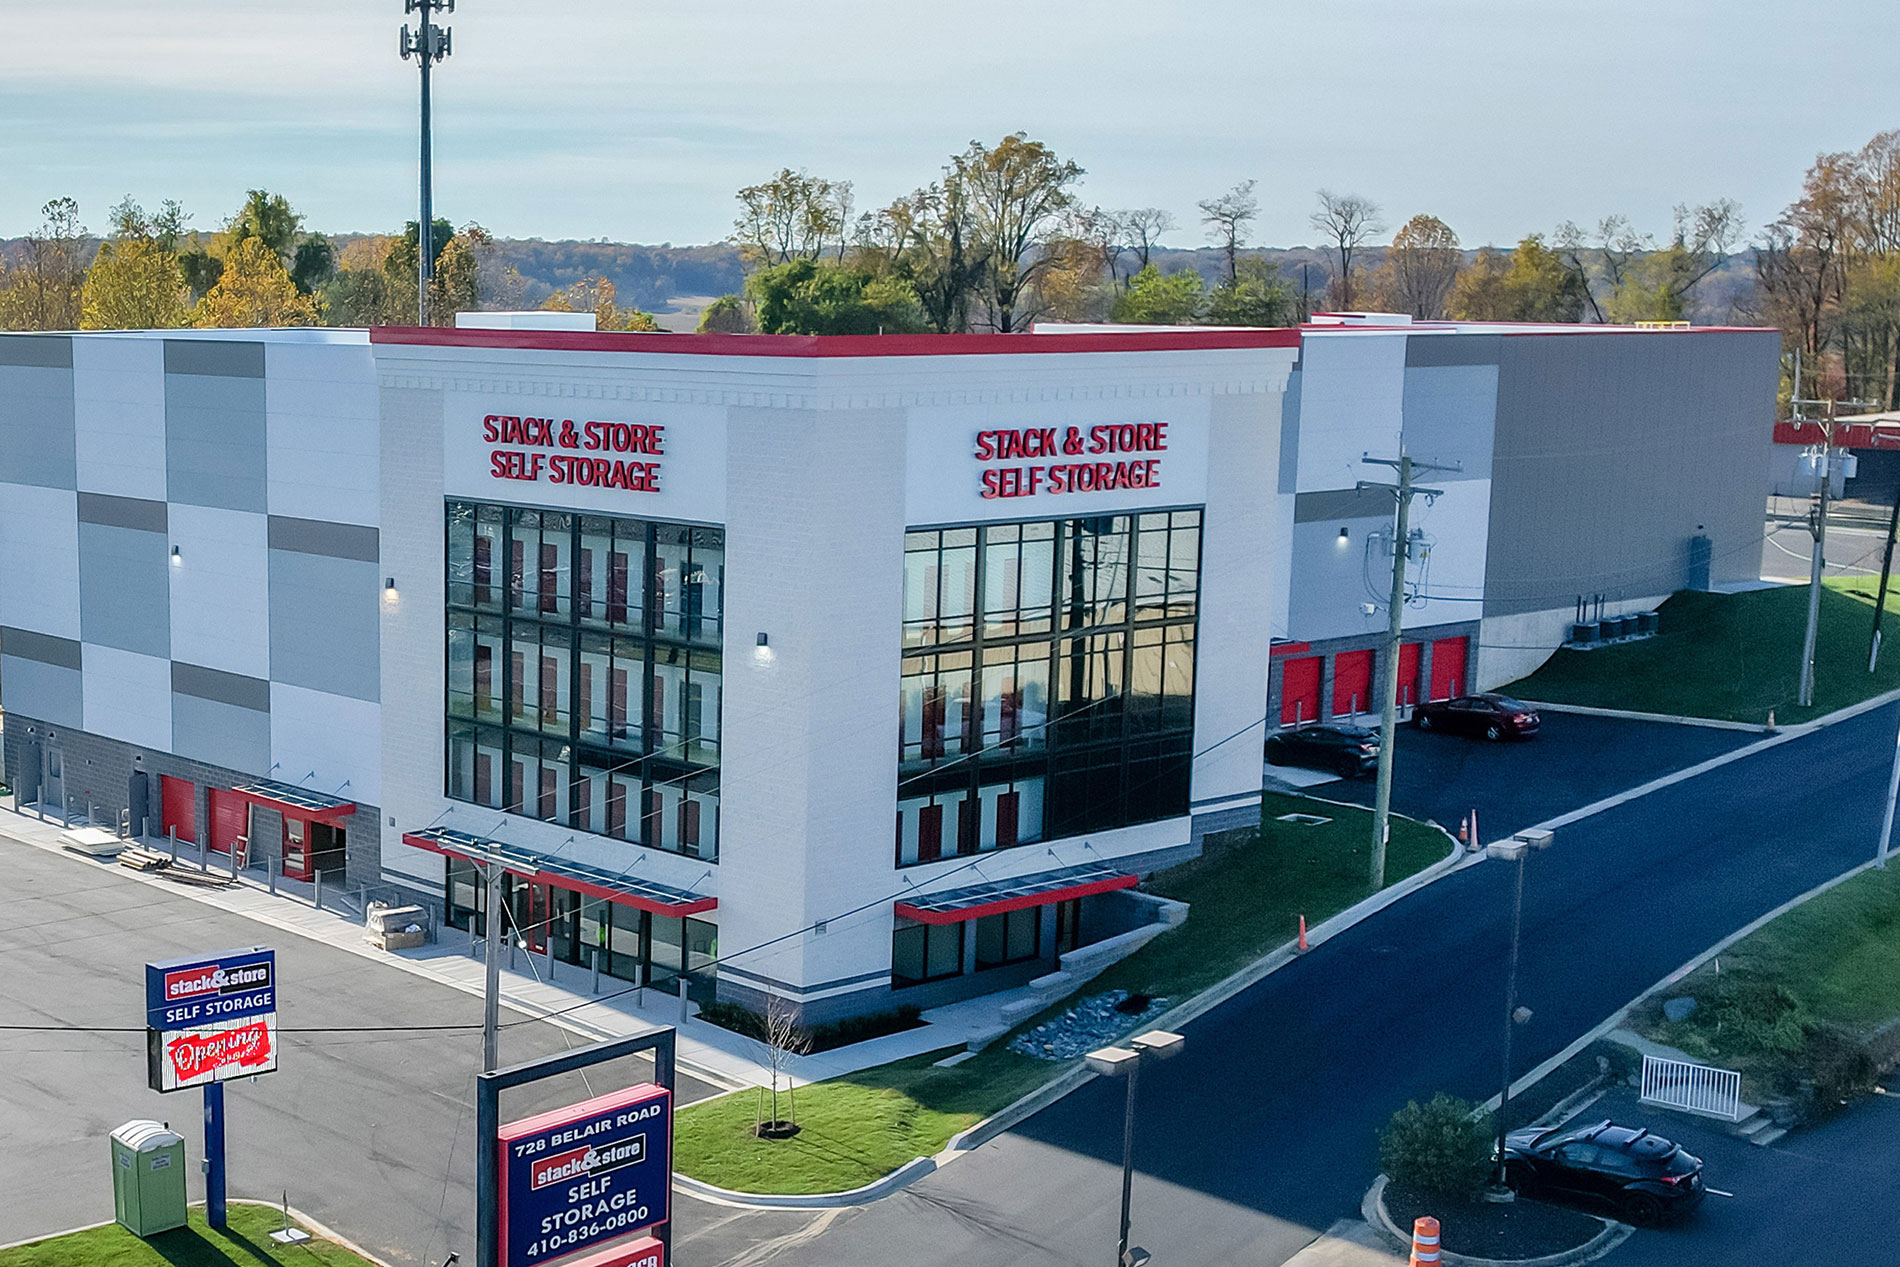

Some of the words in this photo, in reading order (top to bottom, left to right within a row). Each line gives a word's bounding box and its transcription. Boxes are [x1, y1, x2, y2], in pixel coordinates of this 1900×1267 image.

[483, 415, 553, 447] STACK
[558, 419, 579, 448] &
[584, 421, 665, 455] STORE
[975, 428, 1057, 460] STACK
[1063, 426, 1084, 455] &
[1089, 422, 1169, 454] STORE
[490, 450, 546, 480] SELF
[548, 455, 661, 492] STORAGE
[981, 466, 1045, 499] SELF
[1048, 459, 1161, 494] STORAGE
[166, 1005, 200, 1023] SELF
[205, 993, 272, 1016] STORAGE
[515, 1139, 546, 1158] 728
[551, 1119, 612, 1147] BELAIR
[616, 1105, 661, 1127] ROAD
[568, 1176, 611, 1203] SELF
[527, 1206, 648, 1257] 410-836-0800
[541, 1189, 636, 1234] STORAGE
